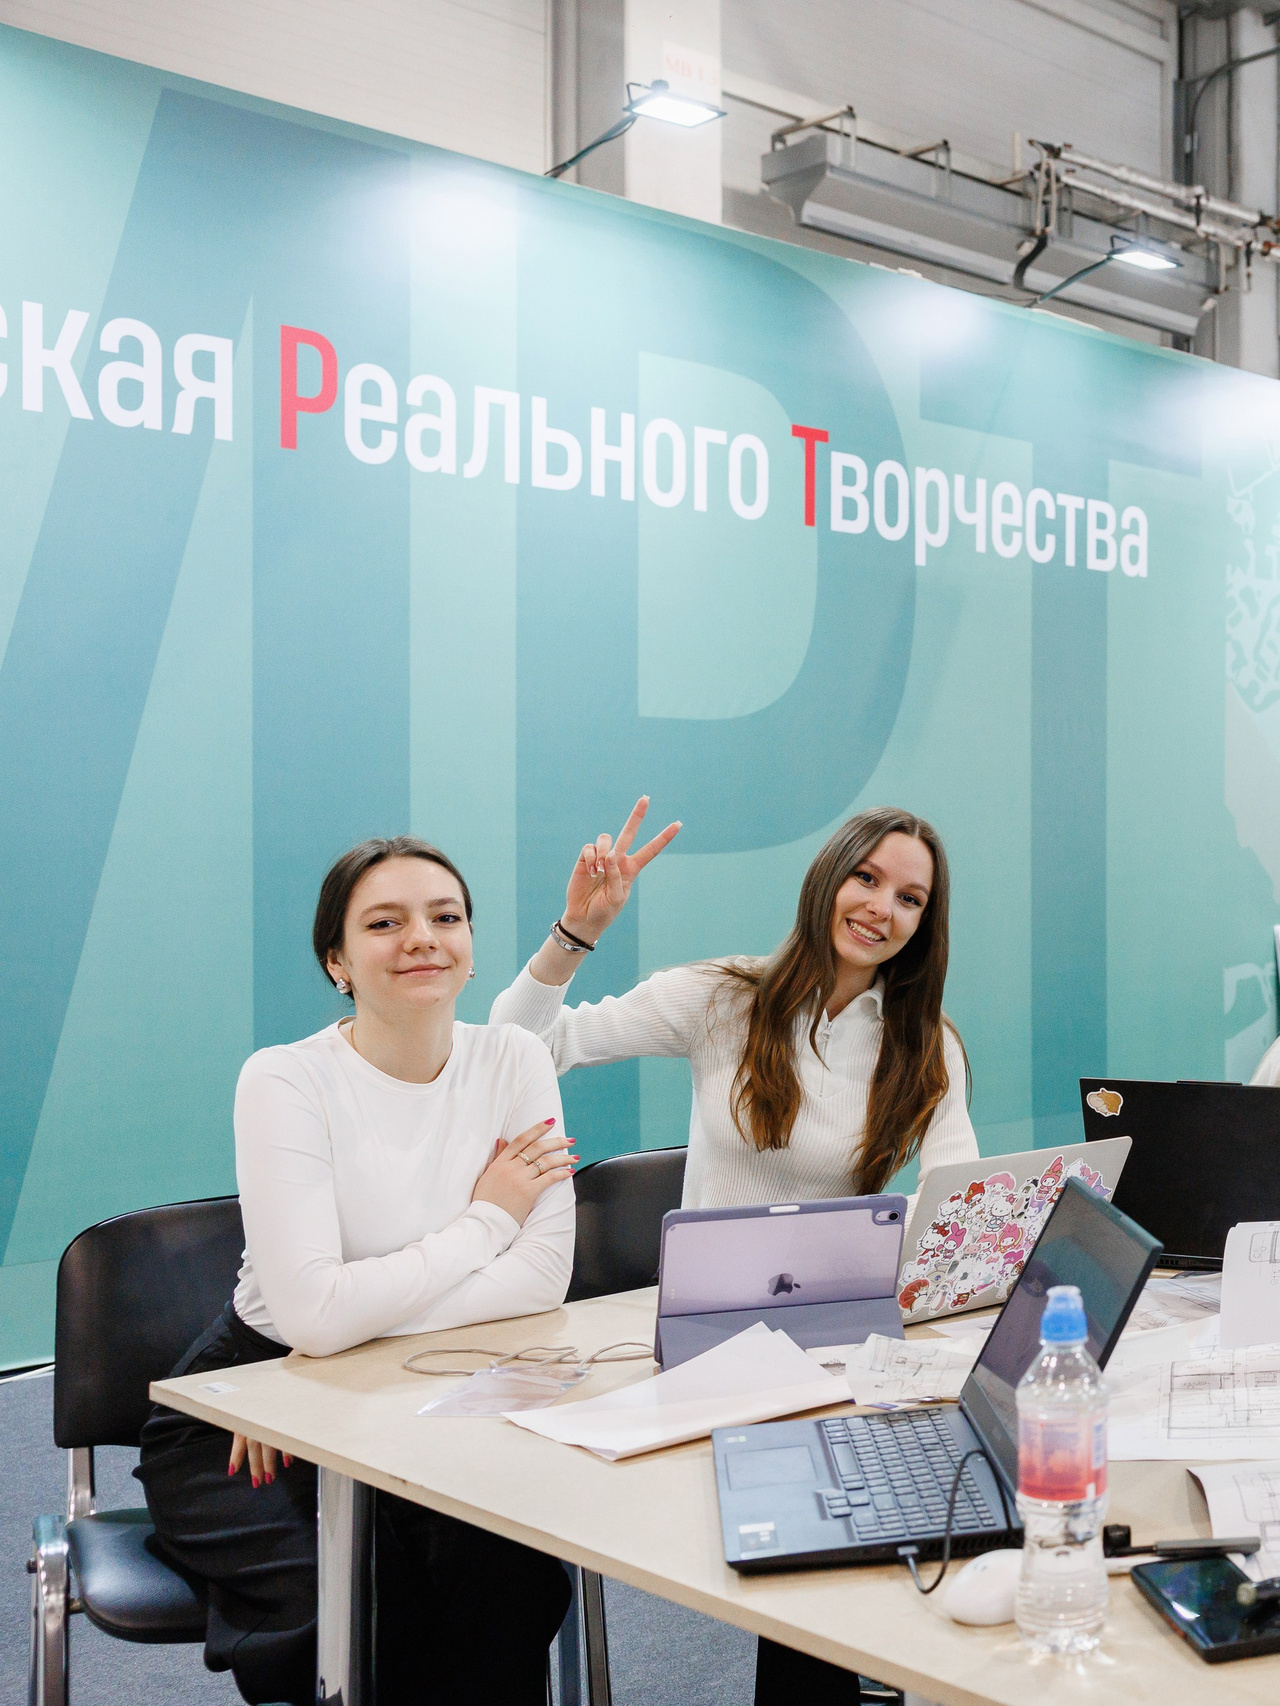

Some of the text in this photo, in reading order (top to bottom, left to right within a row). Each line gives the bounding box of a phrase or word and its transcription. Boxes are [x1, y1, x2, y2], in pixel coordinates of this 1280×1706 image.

[0, 299, 1149, 578] кая Реального Творчества
